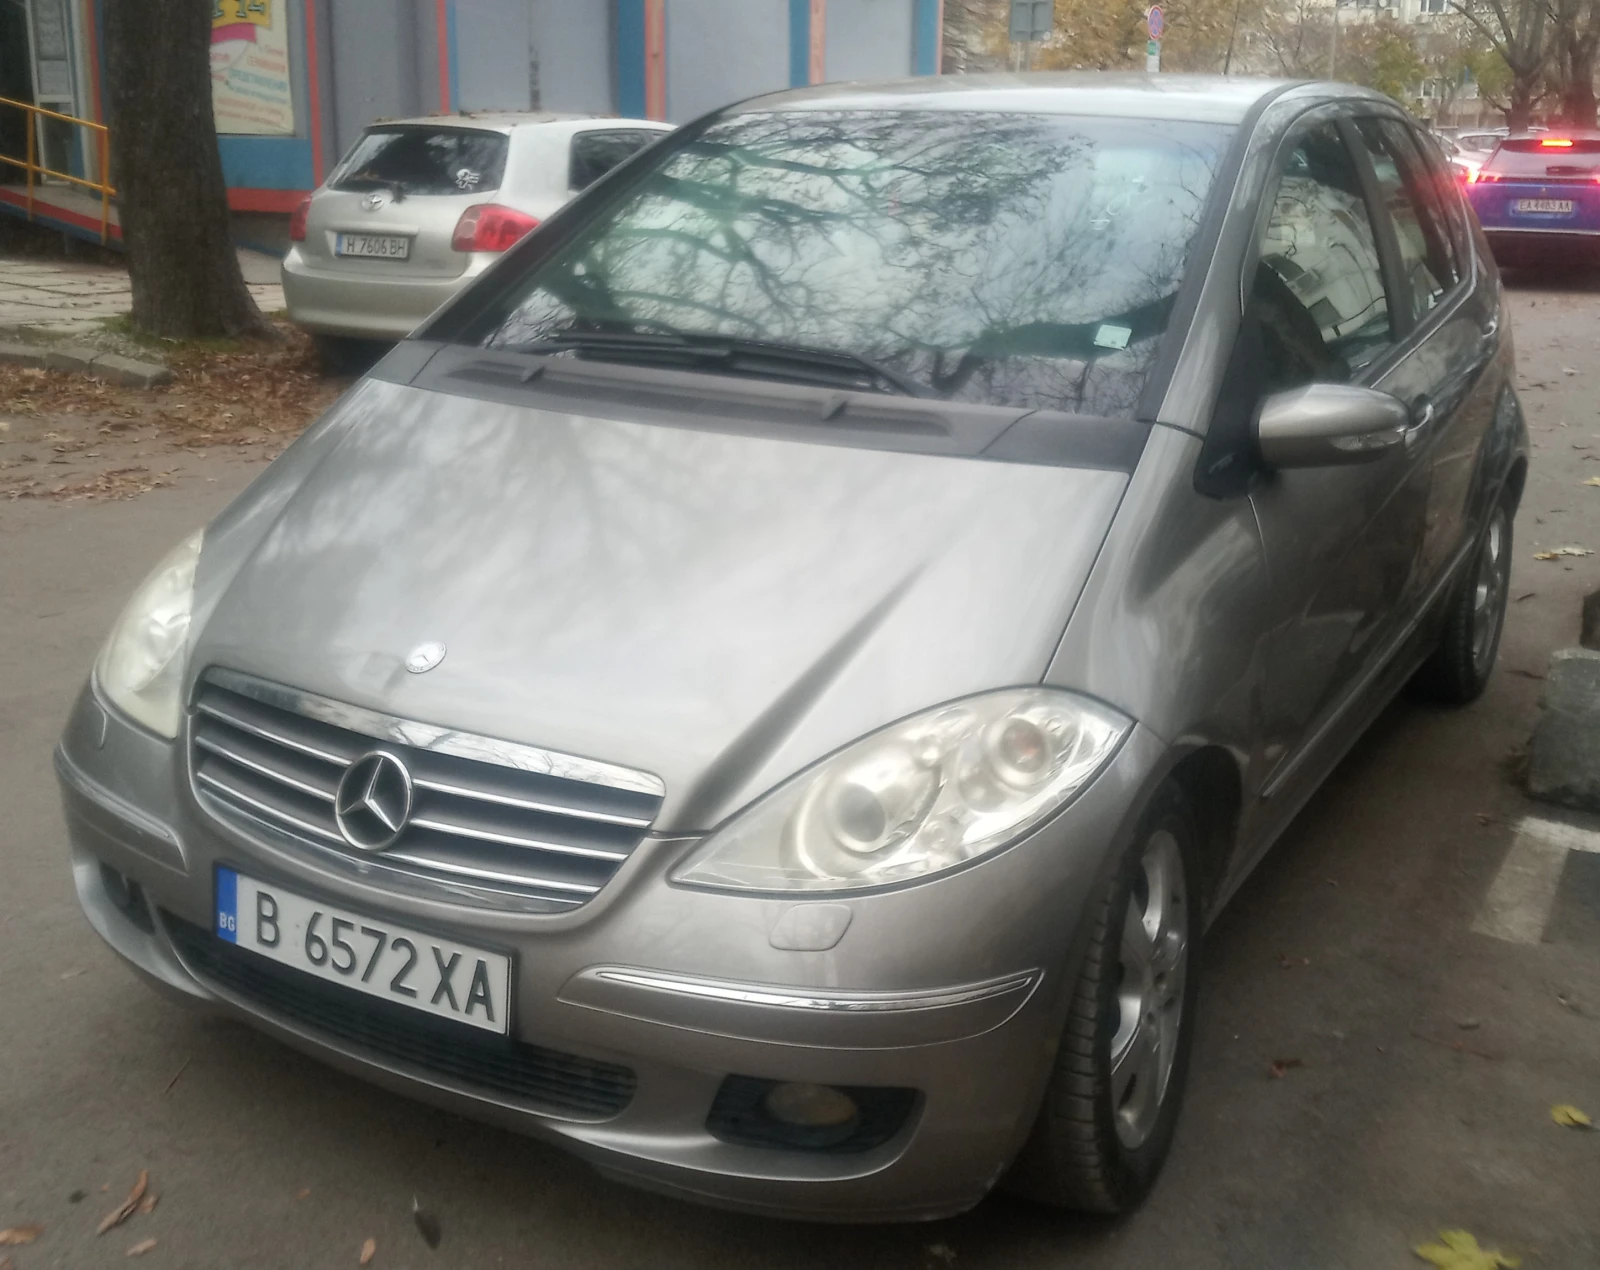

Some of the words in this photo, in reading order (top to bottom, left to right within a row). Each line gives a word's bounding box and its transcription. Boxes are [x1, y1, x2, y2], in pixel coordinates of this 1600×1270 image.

[346, 236, 355, 253] H
[360, 238, 387, 255] 7606
[219, 912, 236, 933] BG
[256, 890, 280, 949] B
[304, 911, 418, 999] 6572
[430, 945, 495, 1023] XA
